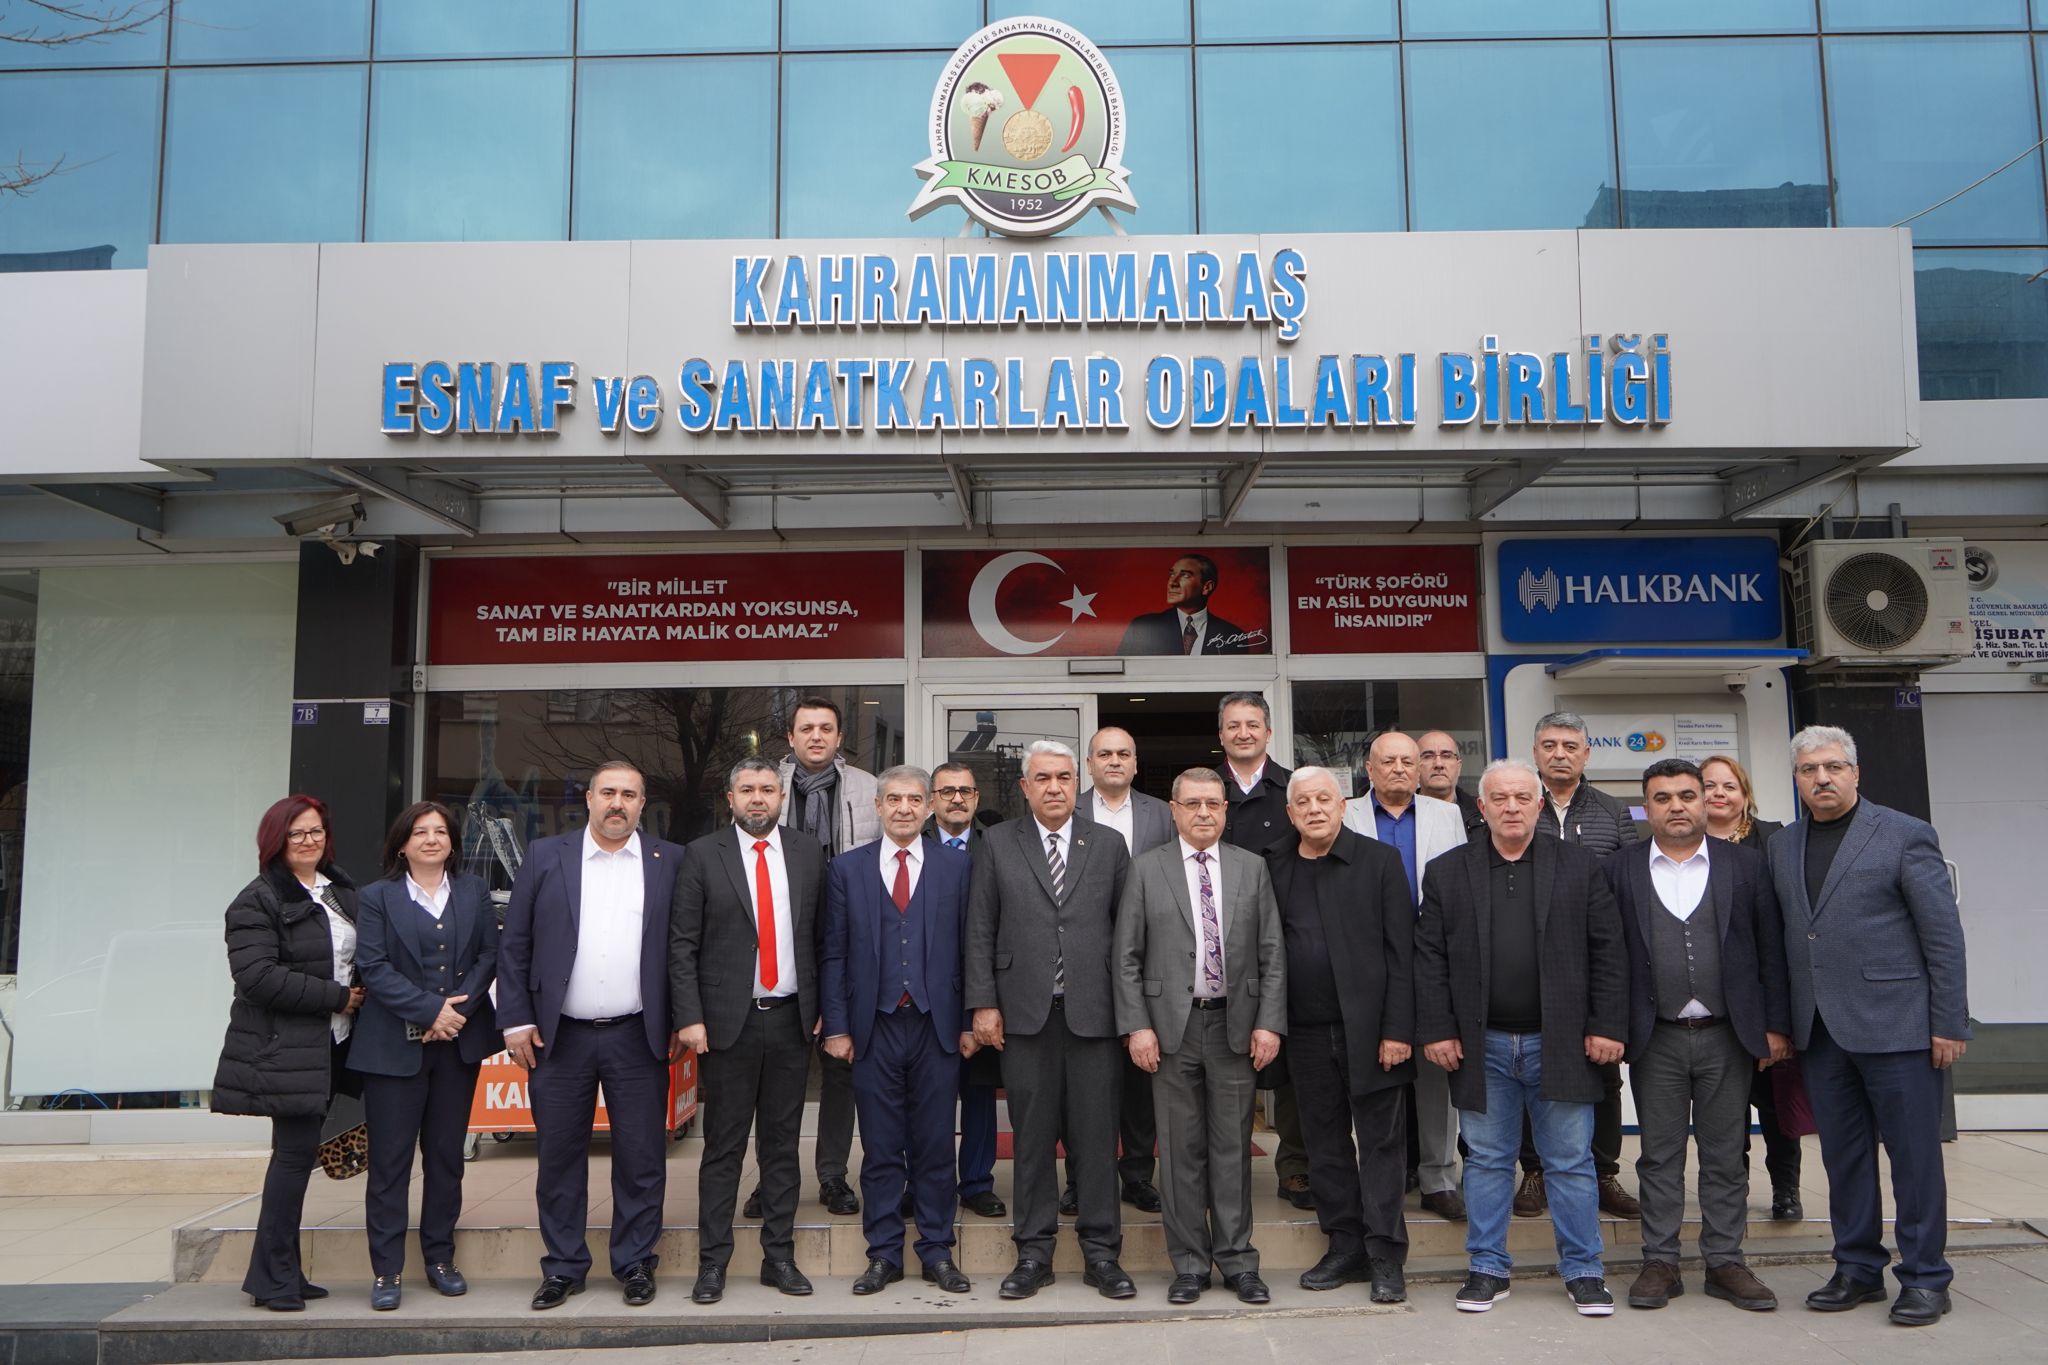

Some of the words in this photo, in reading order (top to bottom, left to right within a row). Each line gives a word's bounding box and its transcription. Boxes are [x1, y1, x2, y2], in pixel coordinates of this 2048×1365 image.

[935, 70, 957, 154] KAHRAMANMARAŞ
[954, 43, 978, 70] ESNAF
[978, 34, 991, 45] VE
[992, 23, 1062, 38] SANATKARLAR
[1063, 32, 1097, 63] ODALARI
[967, 167, 1067, 191] KMESOB
[1009, 198, 1043, 211] 1952
[731, 248, 1309, 344] KAHRAMANMARAŞ
[380, 361, 579, 437] ESNAF
[591, 373, 665, 435] ve
[677, 350, 1130, 436] SANATKARLAR
[1144, 351, 1418, 432] ODALARI
[1437, 333, 1673, 429] BİRLİĞİ
[656, 576, 728, 596] MİLLET
[1375, 572, 1449, 591] ŞOFÖRÜ
[1565, 573, 1764, 604] HALKBANK
[476, 604, 545, 621] SANAT
[550, 604, 577, 620] VE
[581, 601, 736, 619] SANATKARDAN
[742, 600, 859, 618] YOKSUNSA,
[1298, 596, 1321, 609] EN
[1326, 593, 1365, 609] ASİL
[1369, 594, 1468, 609] DUYGUNUN
[495, 626, 538, 644] TAM
[543, 623, 577, 643] BİR
[582, 625, 660, 642] HAYATA
[665, 620, 730, 641] MALİK
[1985, 641, 2001, 649] Hiz.
[2003, 641, 2021, 649] San.
[2022, 641, 2038, 649] Tic.
[1991, 650, 2034, 658] GÜVENLİK
[1898, 692, 1917, 705] 7C
[297, 708, 314, 721] 7B
[374, 708, 380, 717] 7
